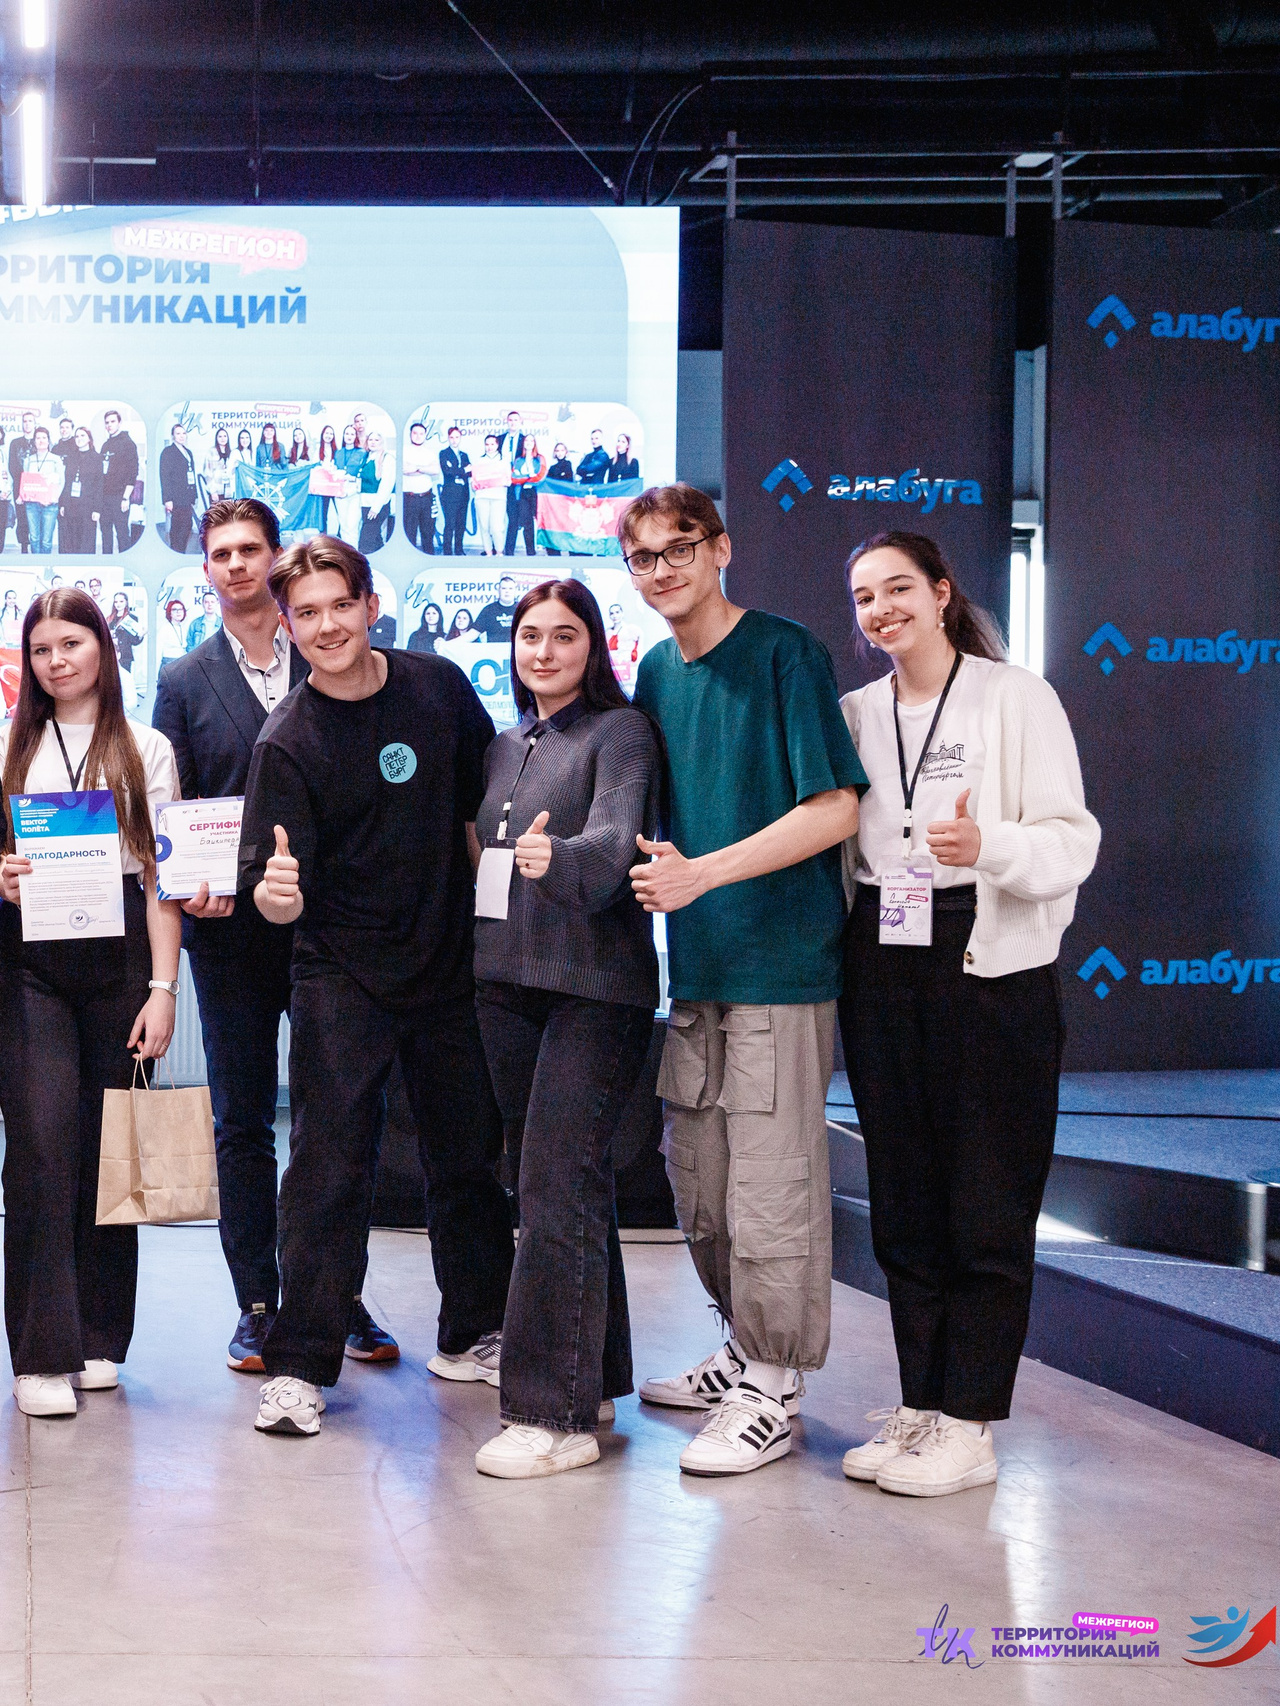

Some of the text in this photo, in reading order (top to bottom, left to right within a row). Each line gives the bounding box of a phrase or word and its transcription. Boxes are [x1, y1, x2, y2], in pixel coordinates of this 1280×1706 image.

[123, 226, 296, 261] МЕЖРЕГИОН
[212, 420, 302, 430] КОММУНИАЦИЙ
[827, 468, 983, 514] алабуга
[445, 582, 530, 592] ТЕРРИТОИЯ
[1146, 629, 1280, 674] алабуг
[382, 747, 404, 763] САНКТ
[385, 756, 408, 771] ПЕТЕР
[388, 766, 407, 780] БУРГ
[189, 820, 241, 832] СЕРТИФИ
[24, 850, 107, 860] БЛАГОДАРНОСТЬ
